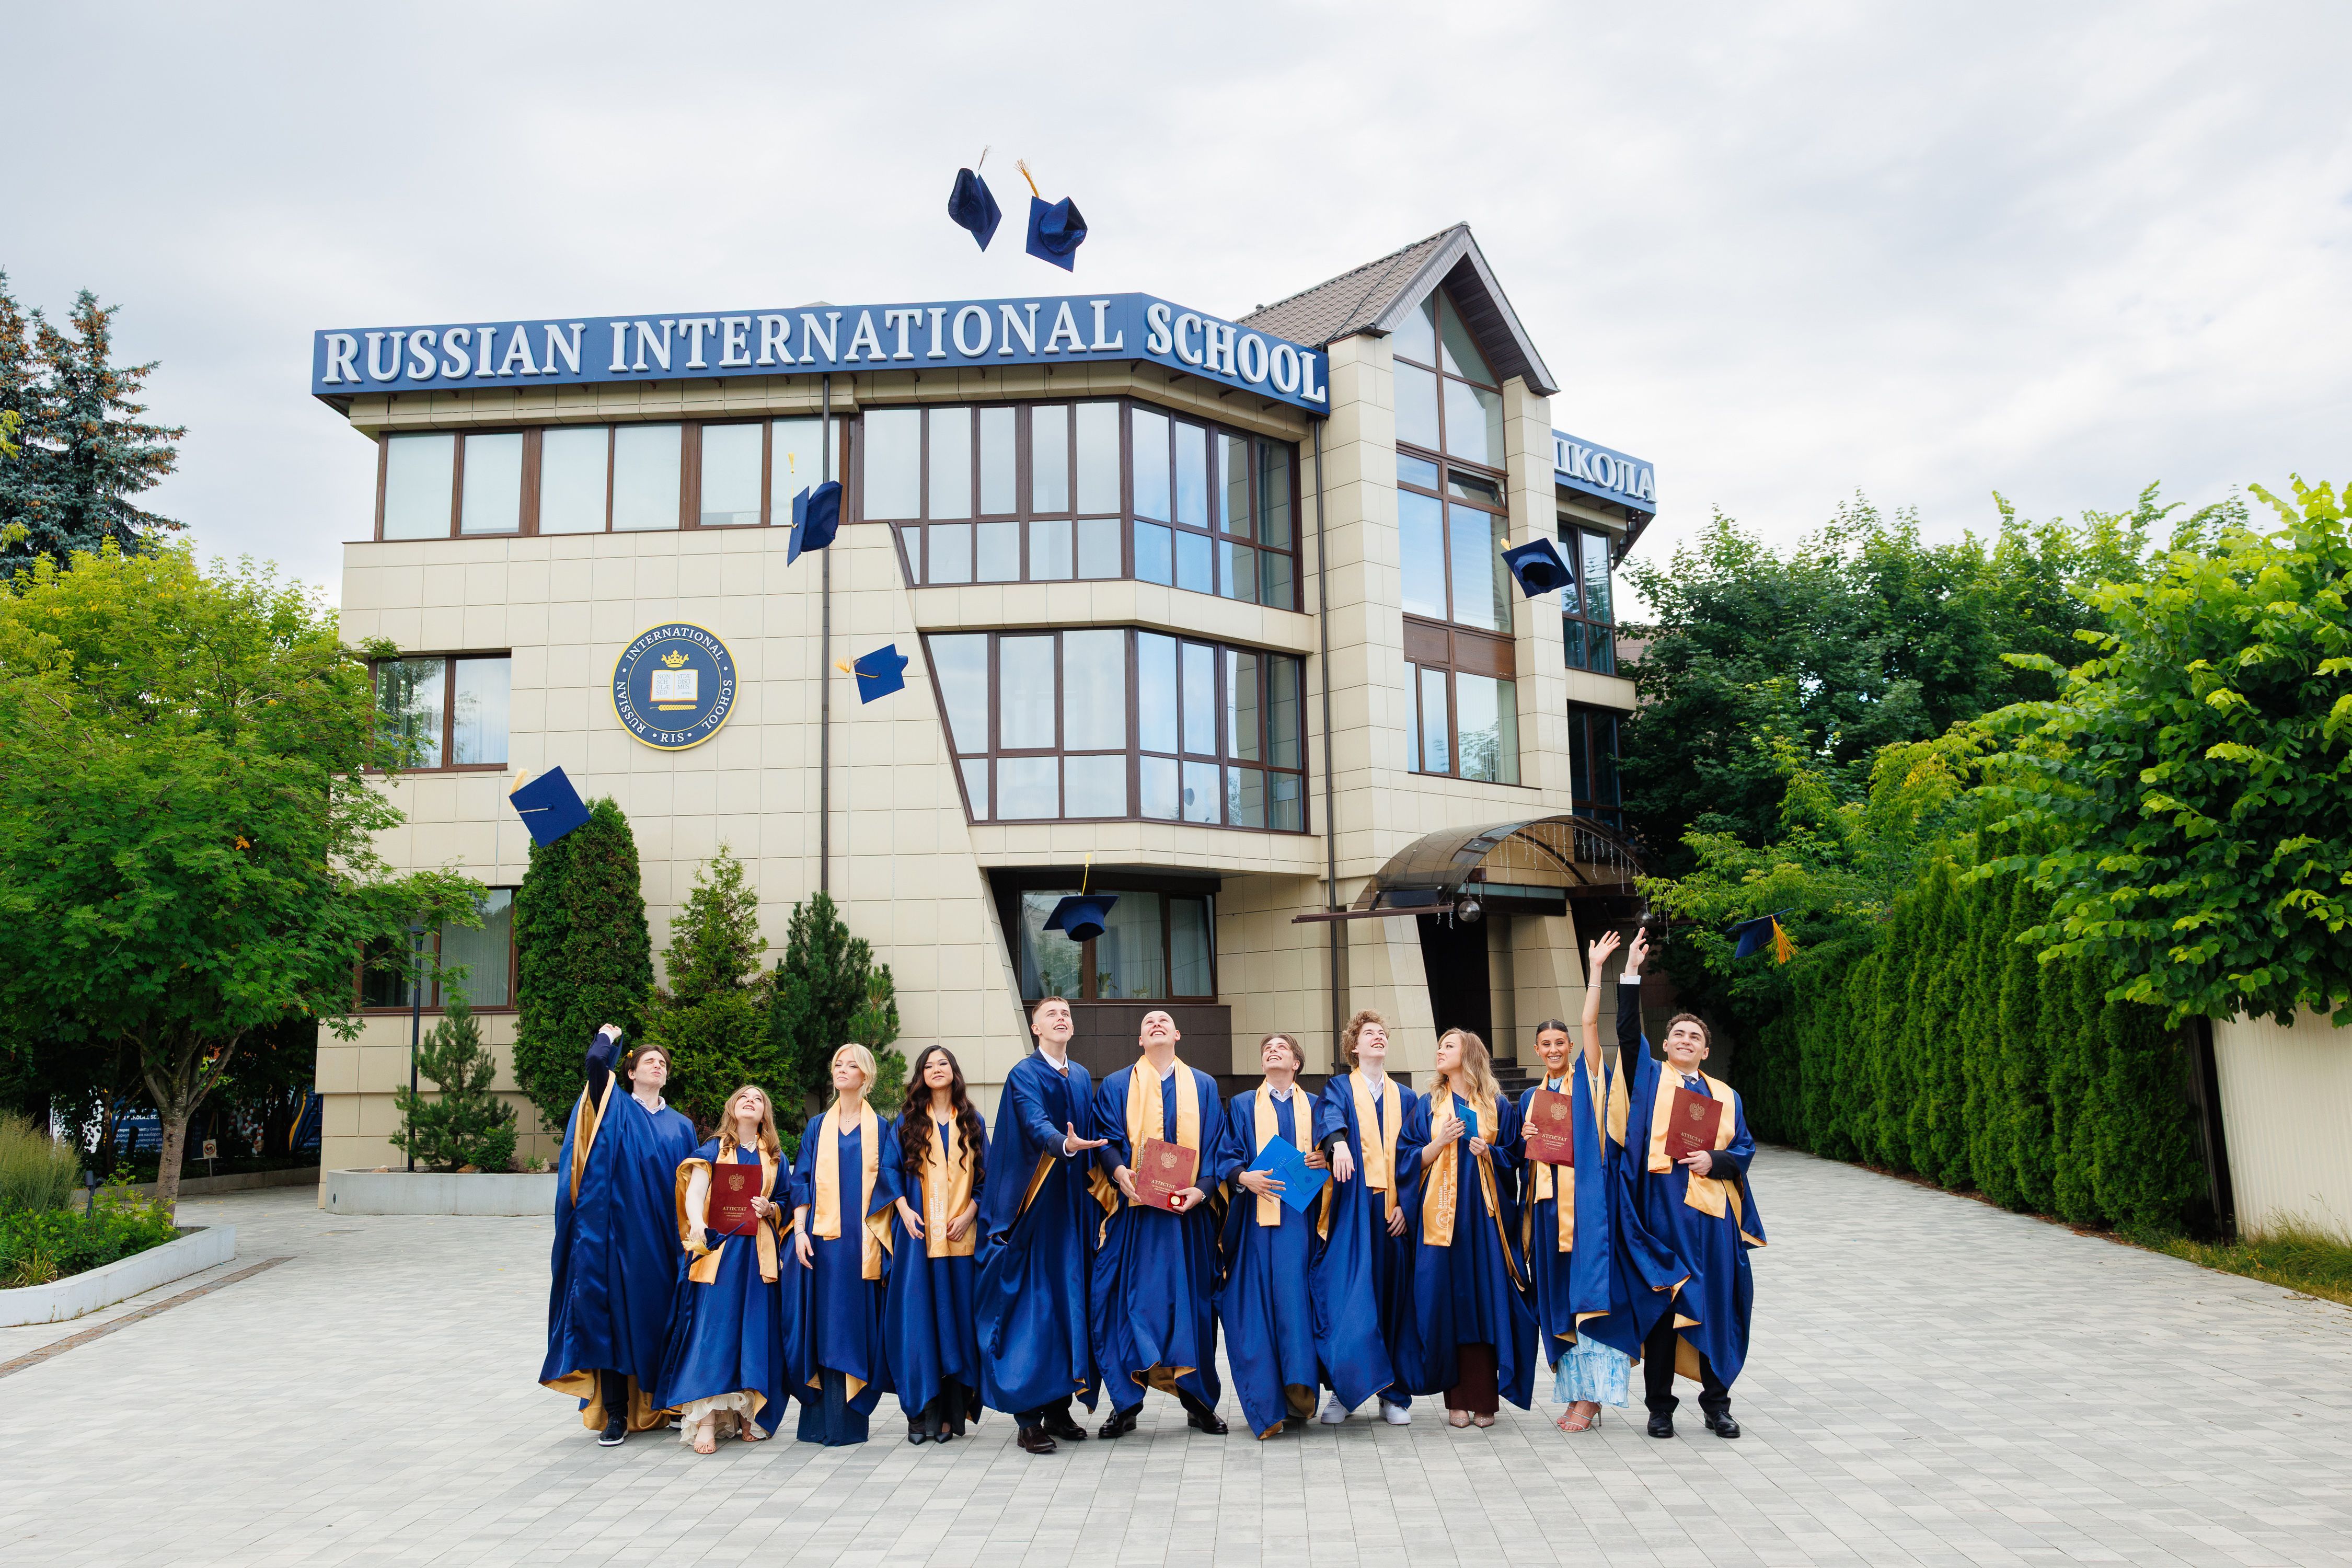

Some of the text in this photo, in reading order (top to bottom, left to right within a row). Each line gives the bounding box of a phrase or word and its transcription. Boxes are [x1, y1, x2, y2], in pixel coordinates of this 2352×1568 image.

[321, 299, 1327, 403] RUSSIAN INTERNATIONAL SCHOOL
[617, 627, 732, 734] RUSSIAN INTERNATIONAL SCHOOL
[660, 733, 684, 743] RIS
[1542, 1133, 1567, 1142] АТТЕСТАТ
[1680, 1132, 1704, 1144] АТТЕСТАТ
[1151, 1179, 1176, 1189] АТТЕСТАТ
